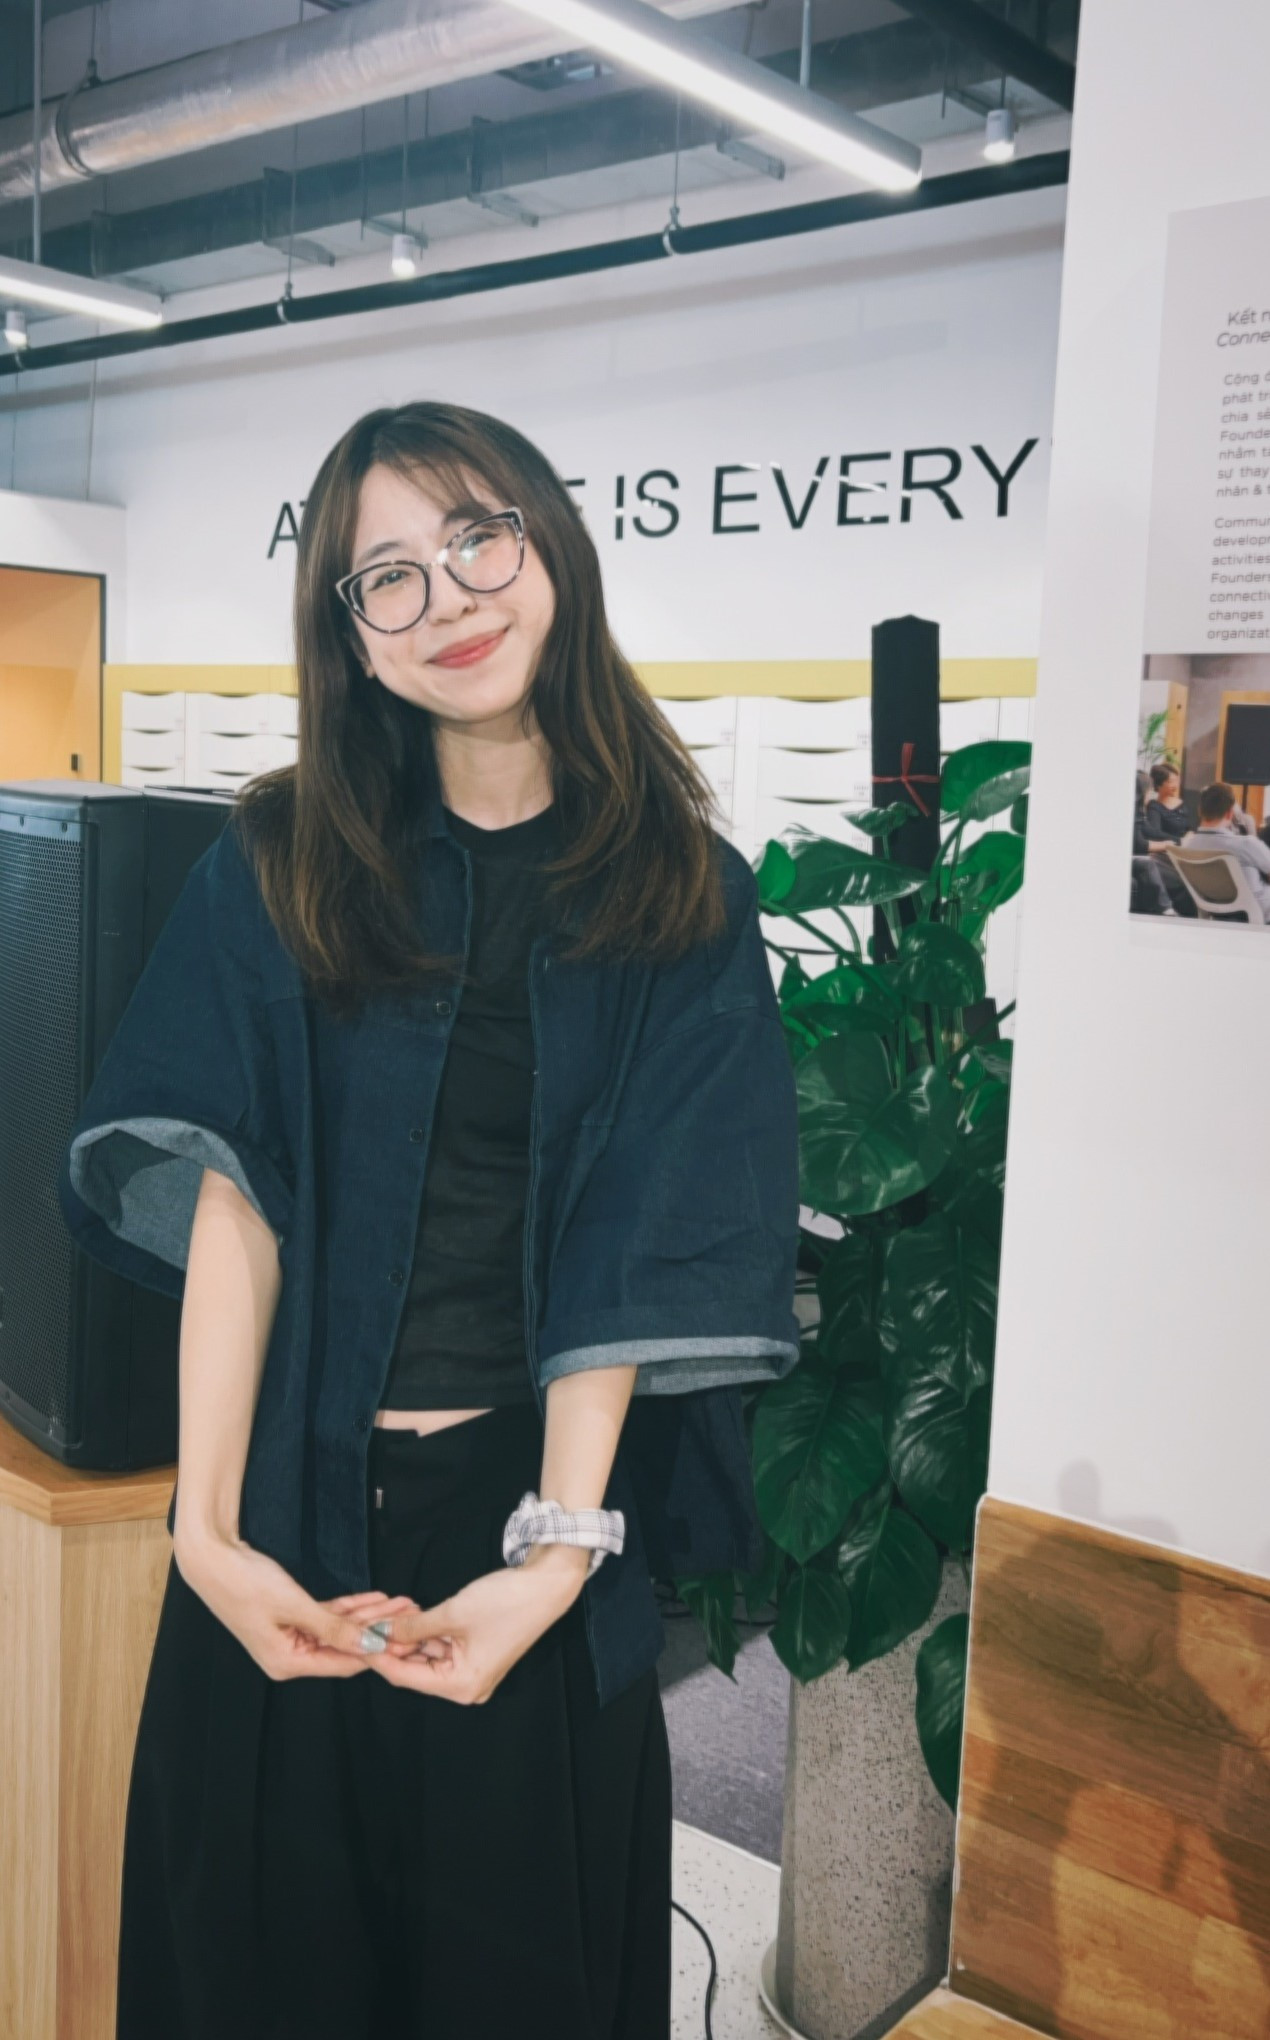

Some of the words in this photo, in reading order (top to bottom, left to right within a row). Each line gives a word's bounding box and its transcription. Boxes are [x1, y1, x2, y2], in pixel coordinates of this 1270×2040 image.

[1227, 306, 1257, 326] Kết
[1216, 331, 1270, 347] Conne
[1224, 373, 1259, 386] Cộng
[1221, 410, 1248, 423] chia
[1220, 428, 1270, 441] Founde
[1239, 466, 1270, 478] thay
[615, 469, 680, 540] IS
[712, 437, 1053, 534] EVERY
[1208, 610, 1264, 622] changes
